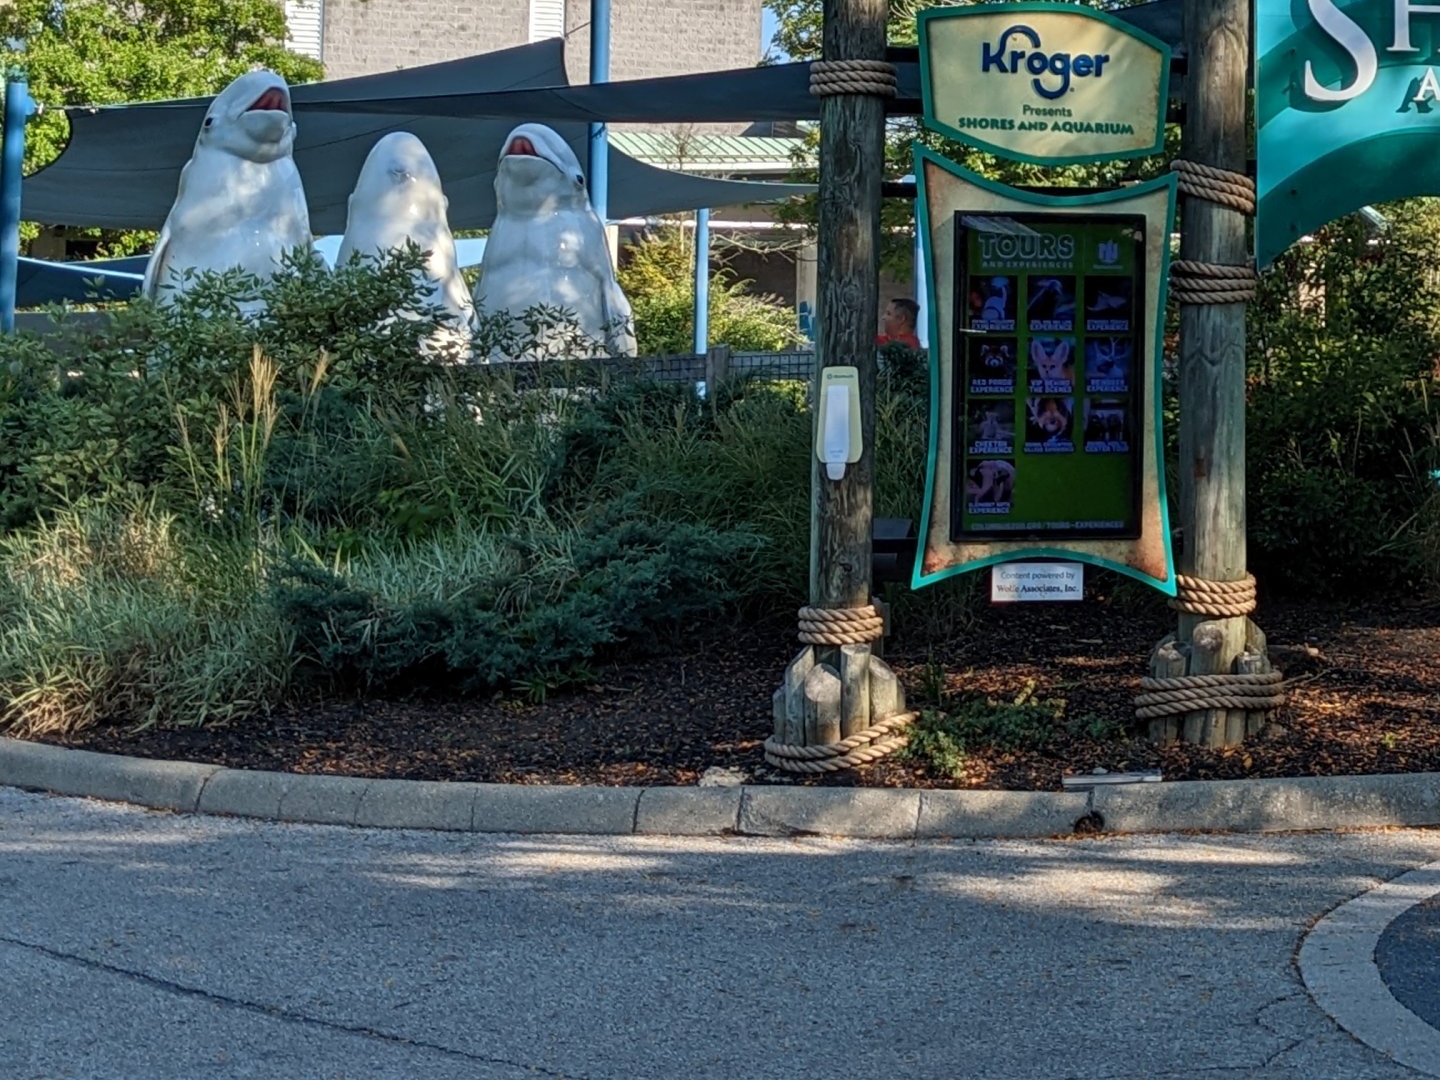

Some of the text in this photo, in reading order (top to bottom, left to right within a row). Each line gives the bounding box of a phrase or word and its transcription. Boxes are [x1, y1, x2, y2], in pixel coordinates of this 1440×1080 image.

[982, 25, 1110, 100] Kroger
[1022, 104, 1072, 117] Presents
[958, 117, 1134, 135] SHORES AND AQUARIUM
[978, 233, 1074, 259] TOURS
[1000, 571, 1075, 580] Content powered by
[1020, 584, 1063, 593] Associates,
[1065, 584, 1079, 592] Inc.
